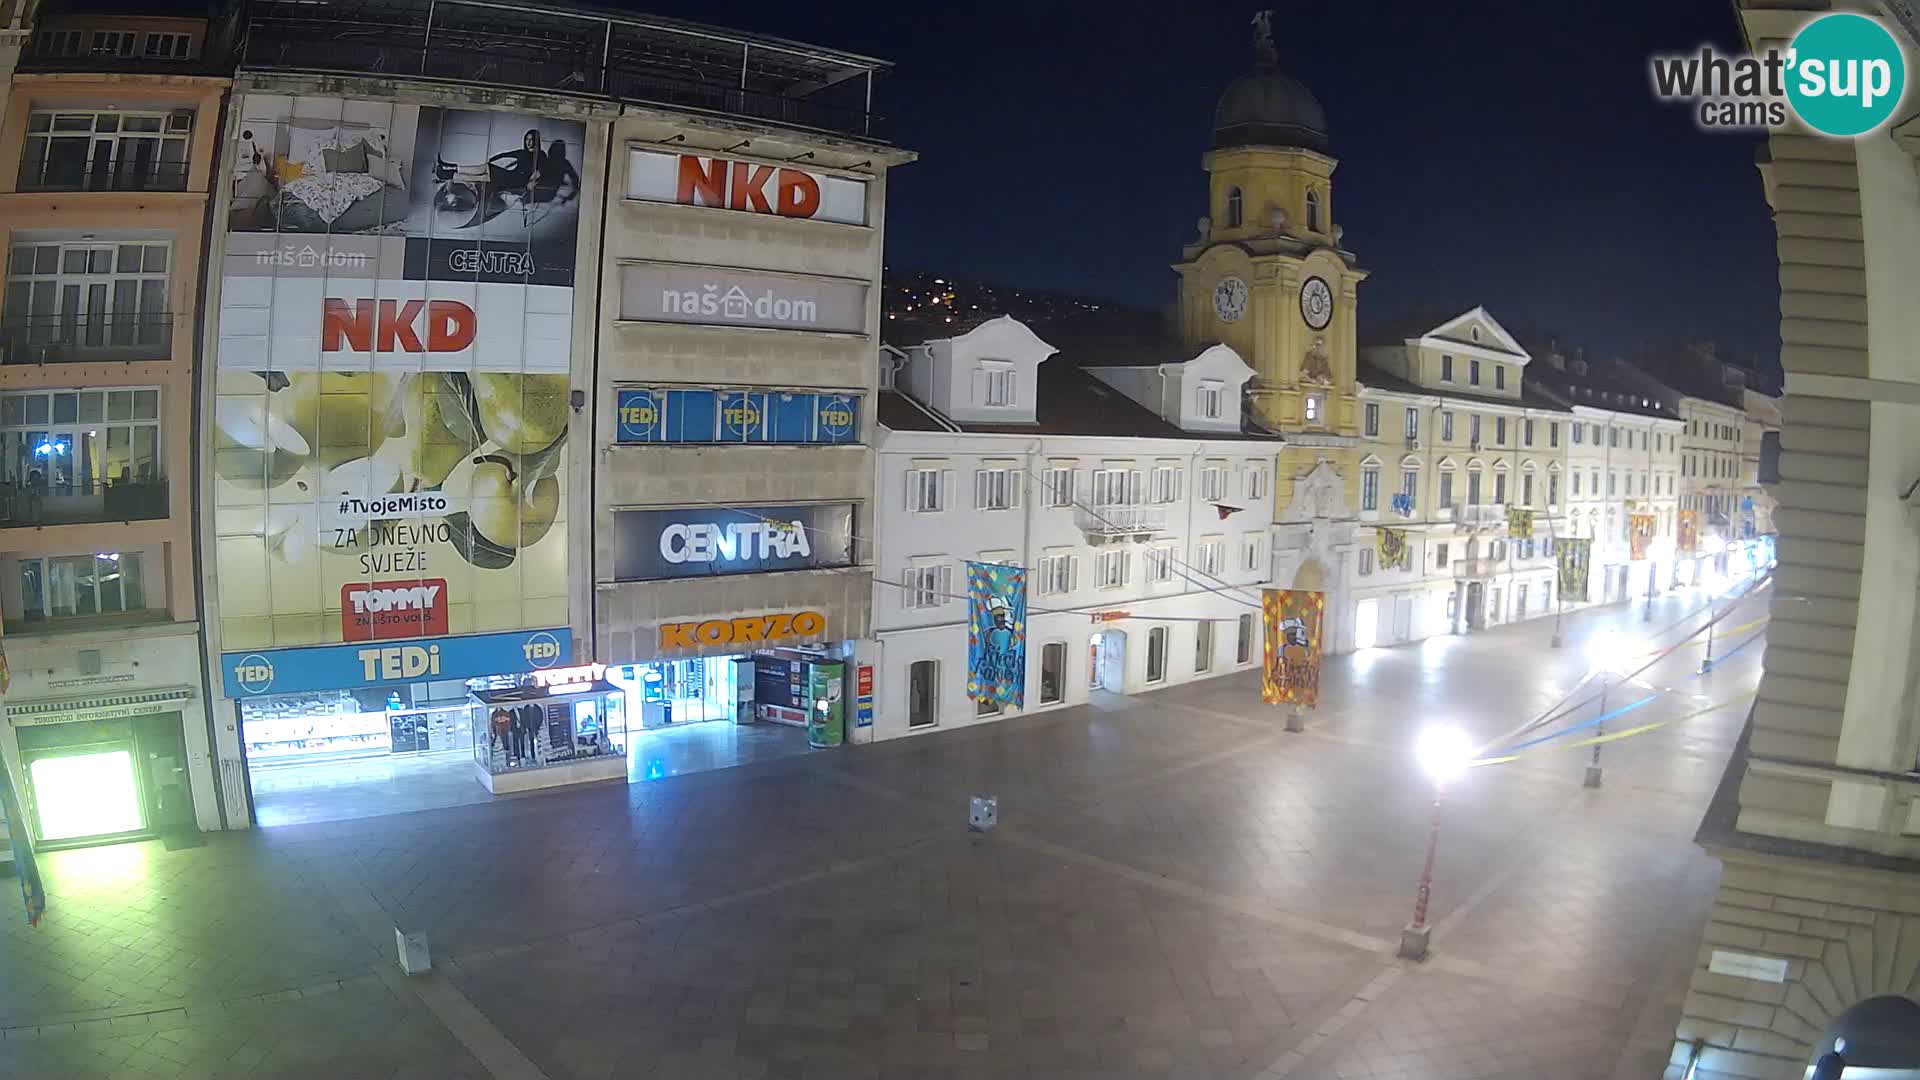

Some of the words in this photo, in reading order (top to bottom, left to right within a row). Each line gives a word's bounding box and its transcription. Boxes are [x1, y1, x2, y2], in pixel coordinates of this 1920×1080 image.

[676, 154, 820, 219] NKD
[256, 246, 296, 267] naš
[320, 246, 368, 268] dom
[449, 249, 536, 275] CENTRA
[661, 283, 718, 316] naš
[754, 292, 817, 322] dom
[322, 297, 478, 353] NKD
[619, 406, 658, 424] TEDi
[724, 408, 760, 425] TEDi
[339, 496, 447, 516] #TvojeMisto
[334, 528, 358, 548] ZA
[369, 523, 451, 547] DNEVNO
[660, 521, 811, 563] CENTRA
[360, 546, 427, 574] SVJEŽE
[350, 586, 440, 613] TOMMY
[659, 611, 826, 649] KORZO
[358, 644, 440, 681] TEDi
[523, 641, 560, 659] TEDi
[235, 665, 274, 682] TEDi
